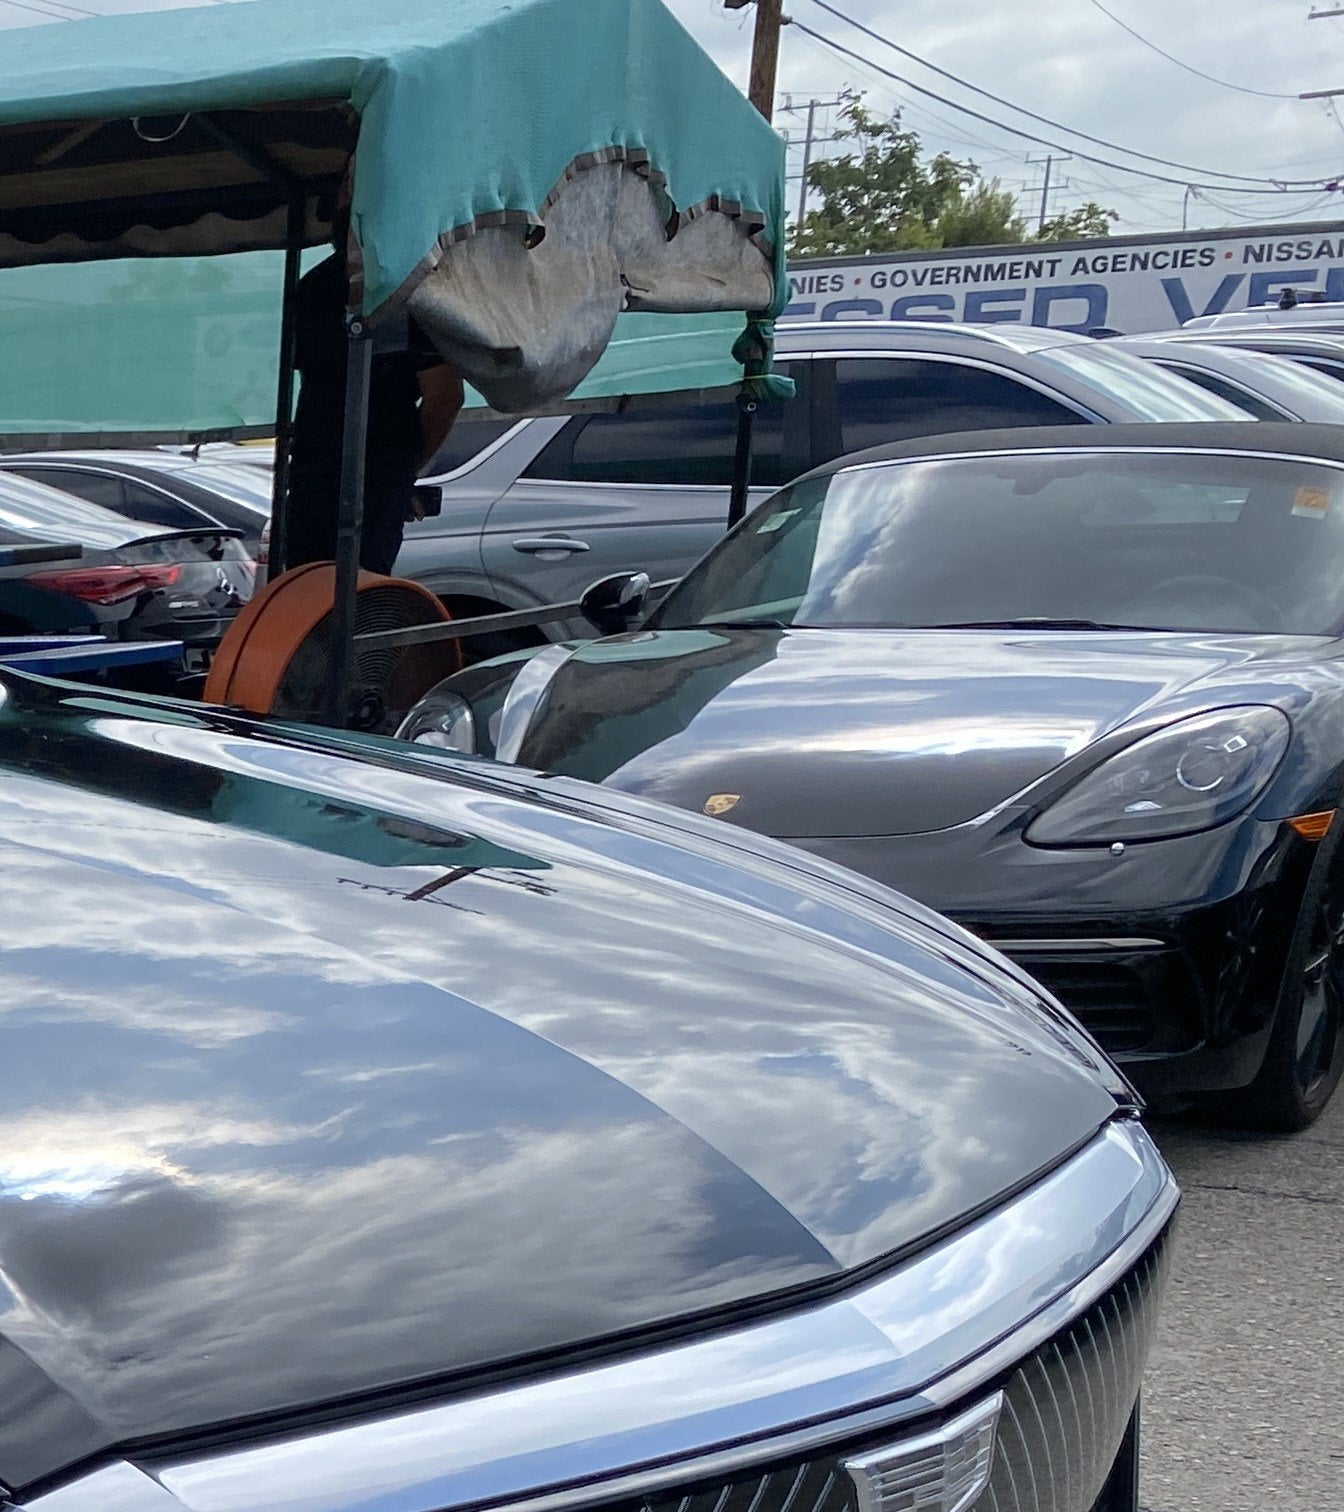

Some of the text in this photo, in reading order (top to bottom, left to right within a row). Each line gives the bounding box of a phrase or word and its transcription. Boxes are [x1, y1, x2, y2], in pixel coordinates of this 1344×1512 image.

[870, 258, 1062, 290] GOVERNMENT
[1071, 247, 1216, 276] AGENCIES
[1243, 239, 1344, 264] NISSA
